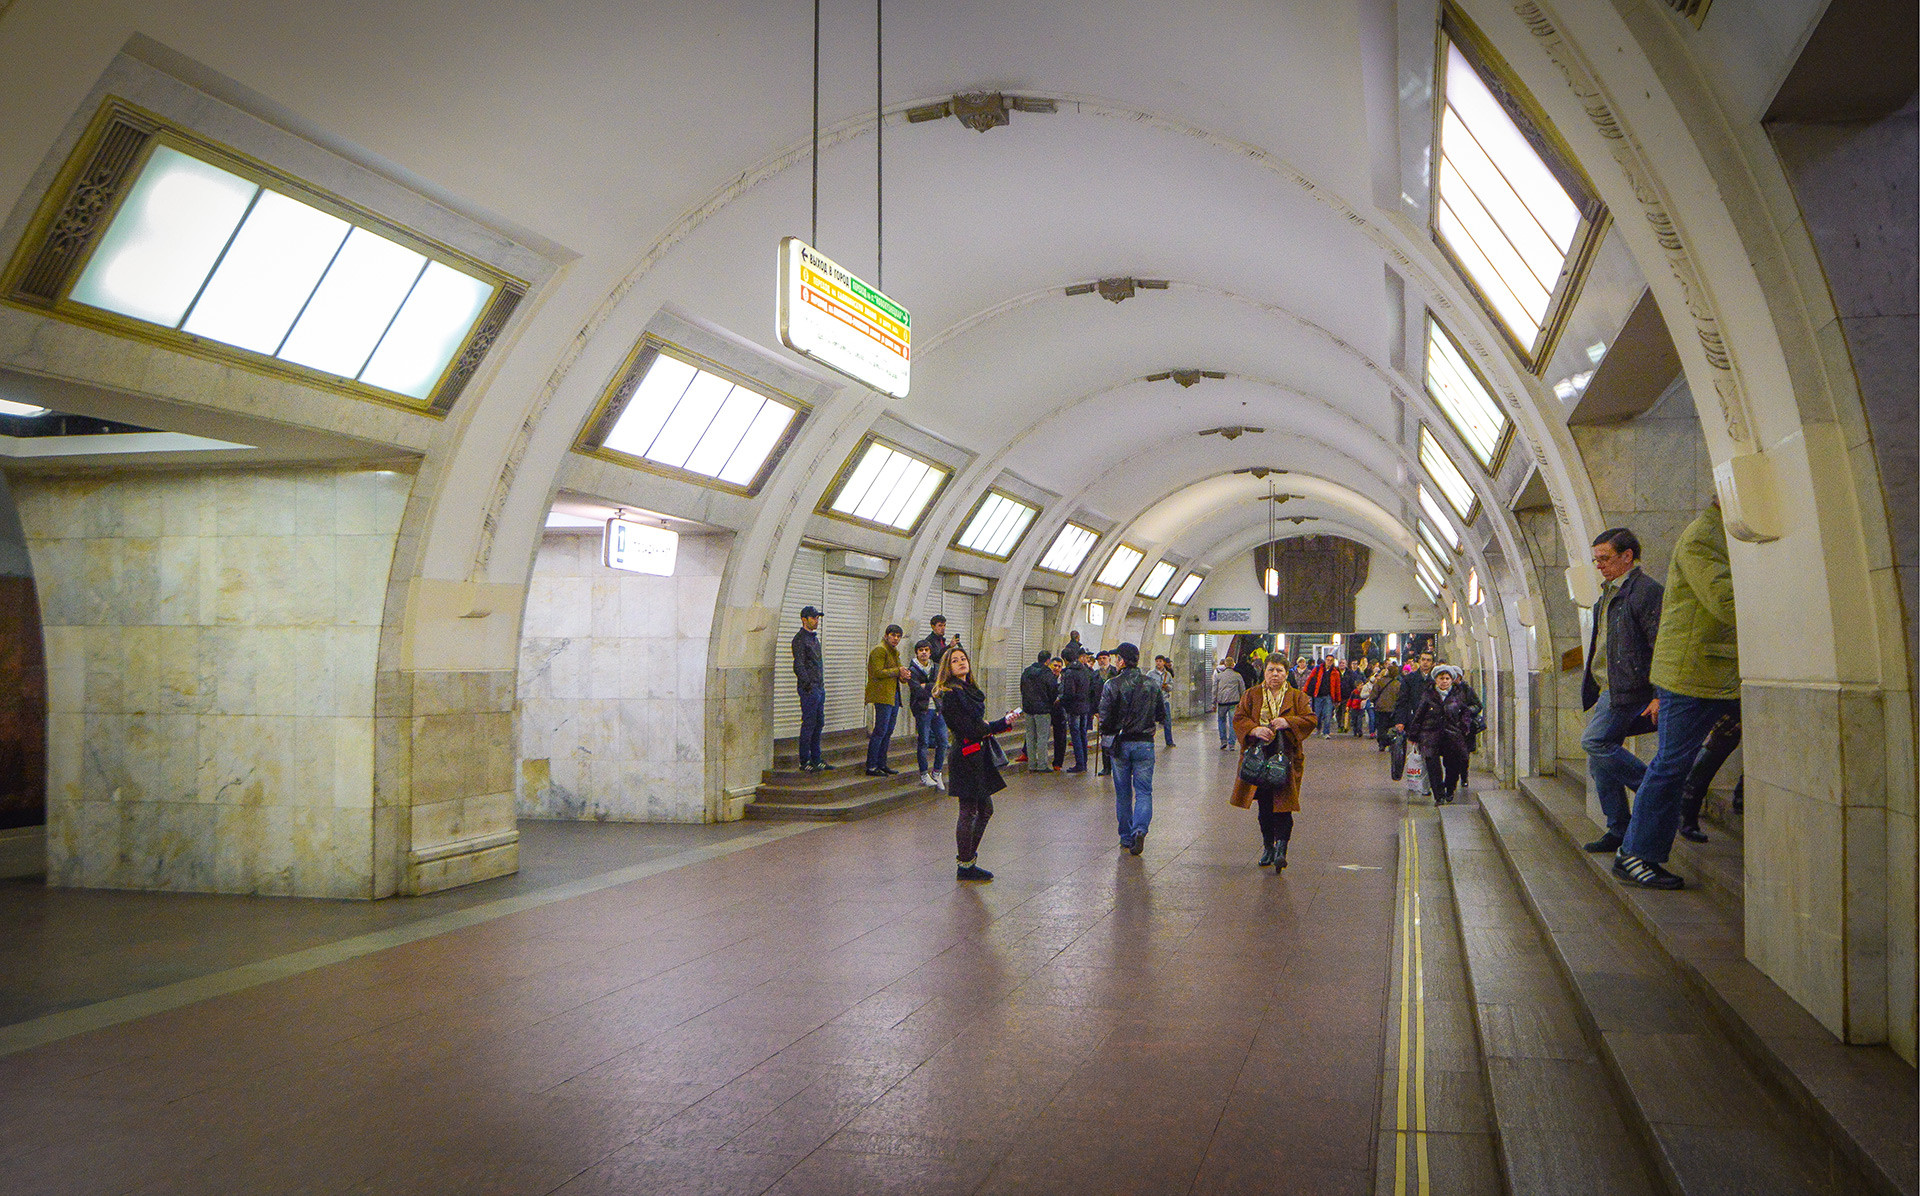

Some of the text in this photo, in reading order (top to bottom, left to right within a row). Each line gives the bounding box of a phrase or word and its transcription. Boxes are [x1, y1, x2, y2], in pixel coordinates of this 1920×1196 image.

[810, 253, 828, 275] ВЫХОД
[829, 265, 833, 276] В
[834, 268, 849, 288] ГОРОД
